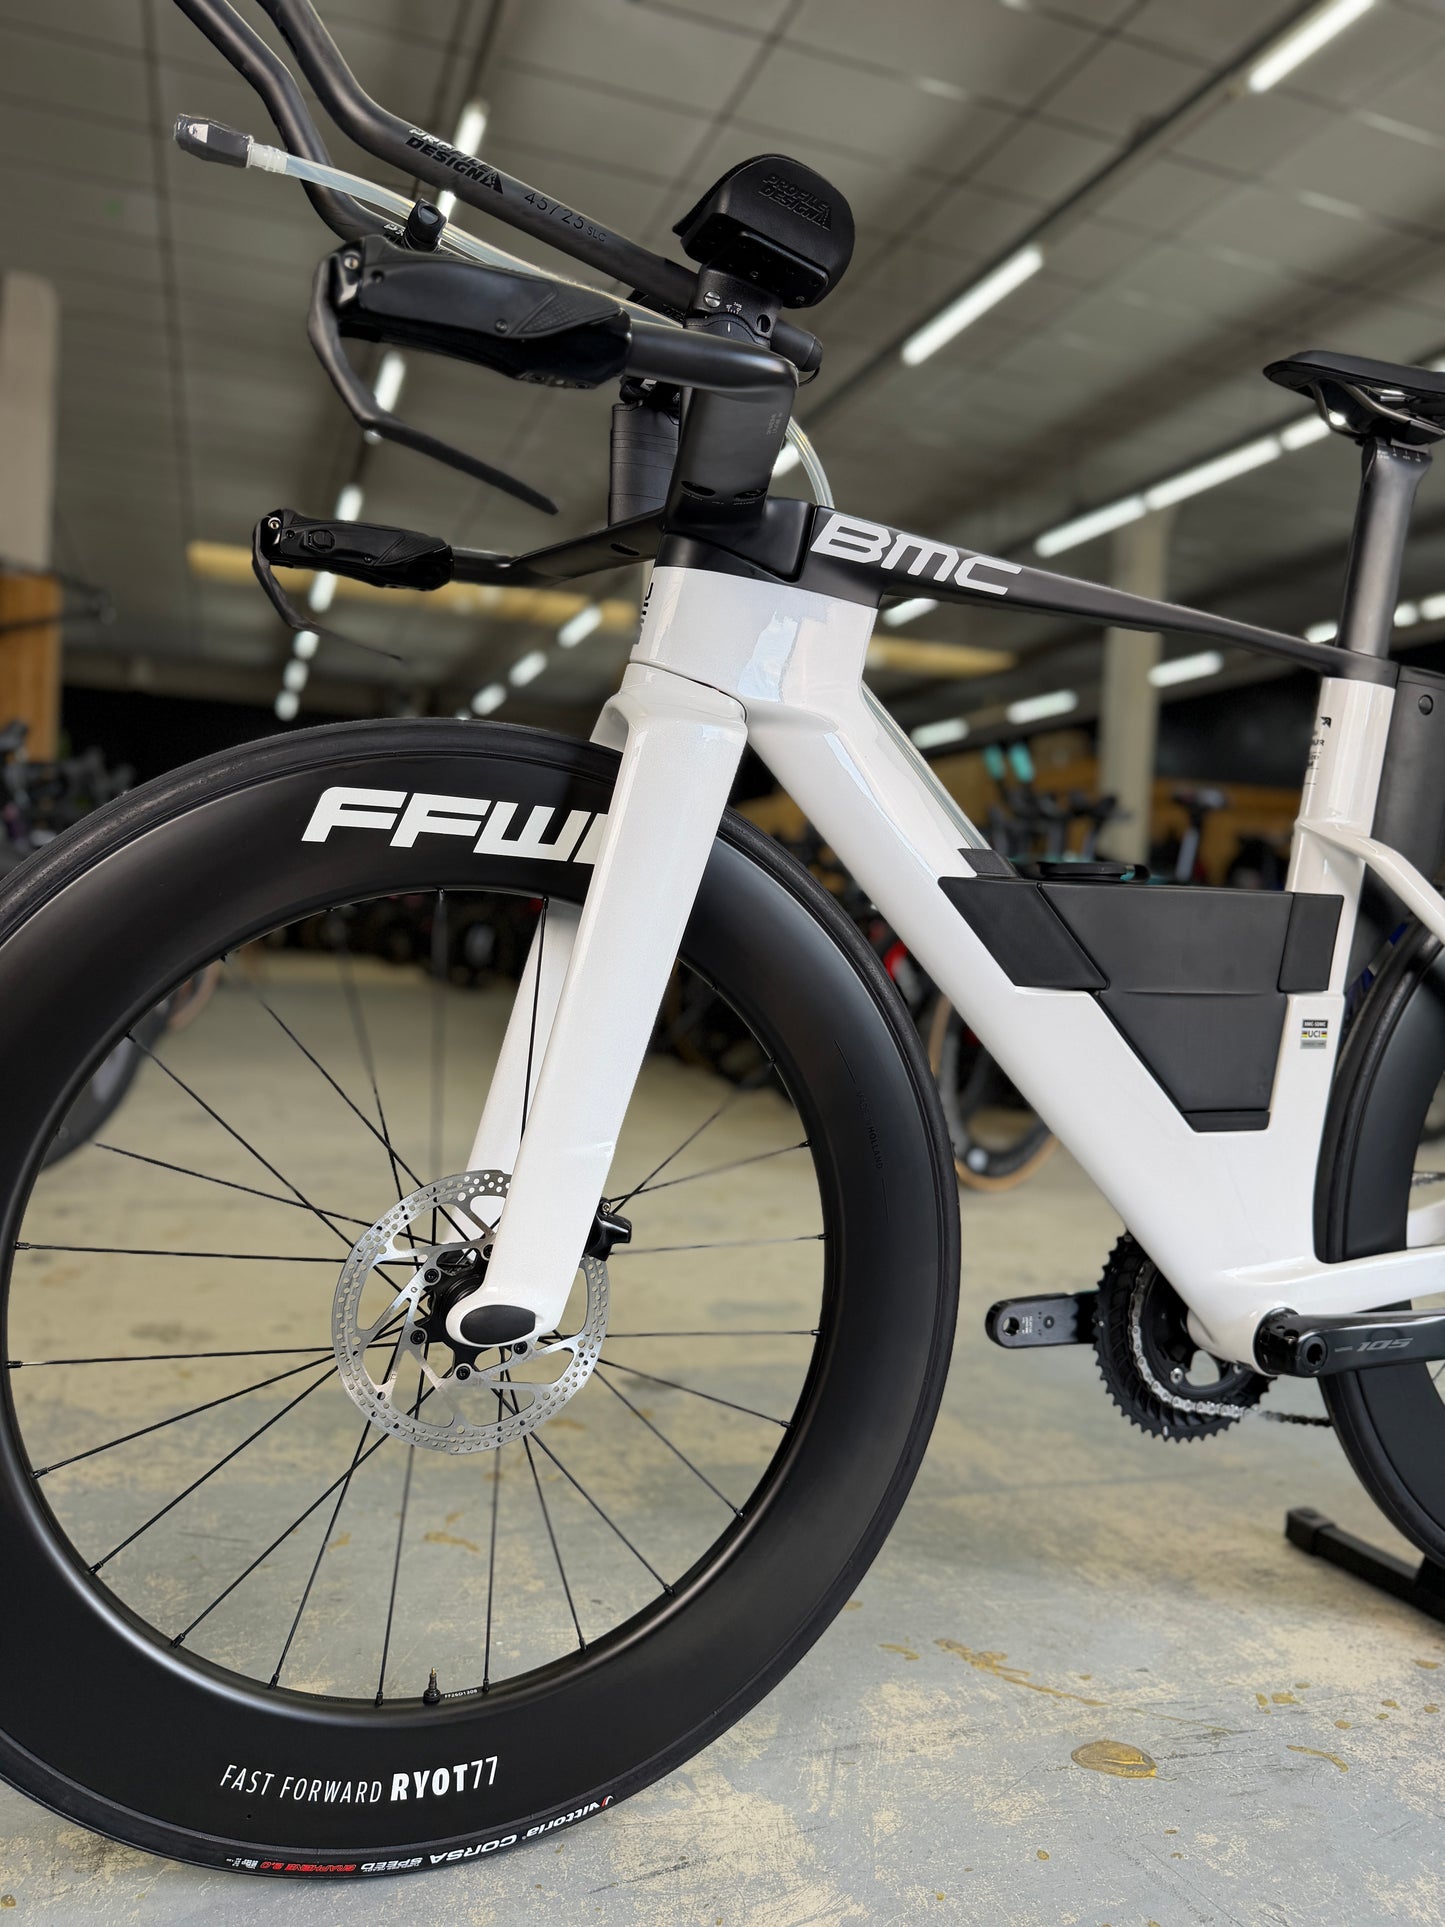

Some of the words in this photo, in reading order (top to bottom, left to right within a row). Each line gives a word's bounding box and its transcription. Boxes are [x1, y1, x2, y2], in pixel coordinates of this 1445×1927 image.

[524, 192, 584, 230] 45/25
[810, 513, 1023, 596] BMC
[1308, 1030, 1320, 1038] UCI
[867, 1126, 883, 1170] HOLLAND
[1356, 1337, 1413, 1352] 105
[220, 1764, 275, 1795] FAST
[280, 1776, 382, 1803] FORWARD
[526, 1801, 600, 1838] vittoria
[361, 1857, 423, 1871] SPEED
[430, 1834, 518, 1864] CORSA
